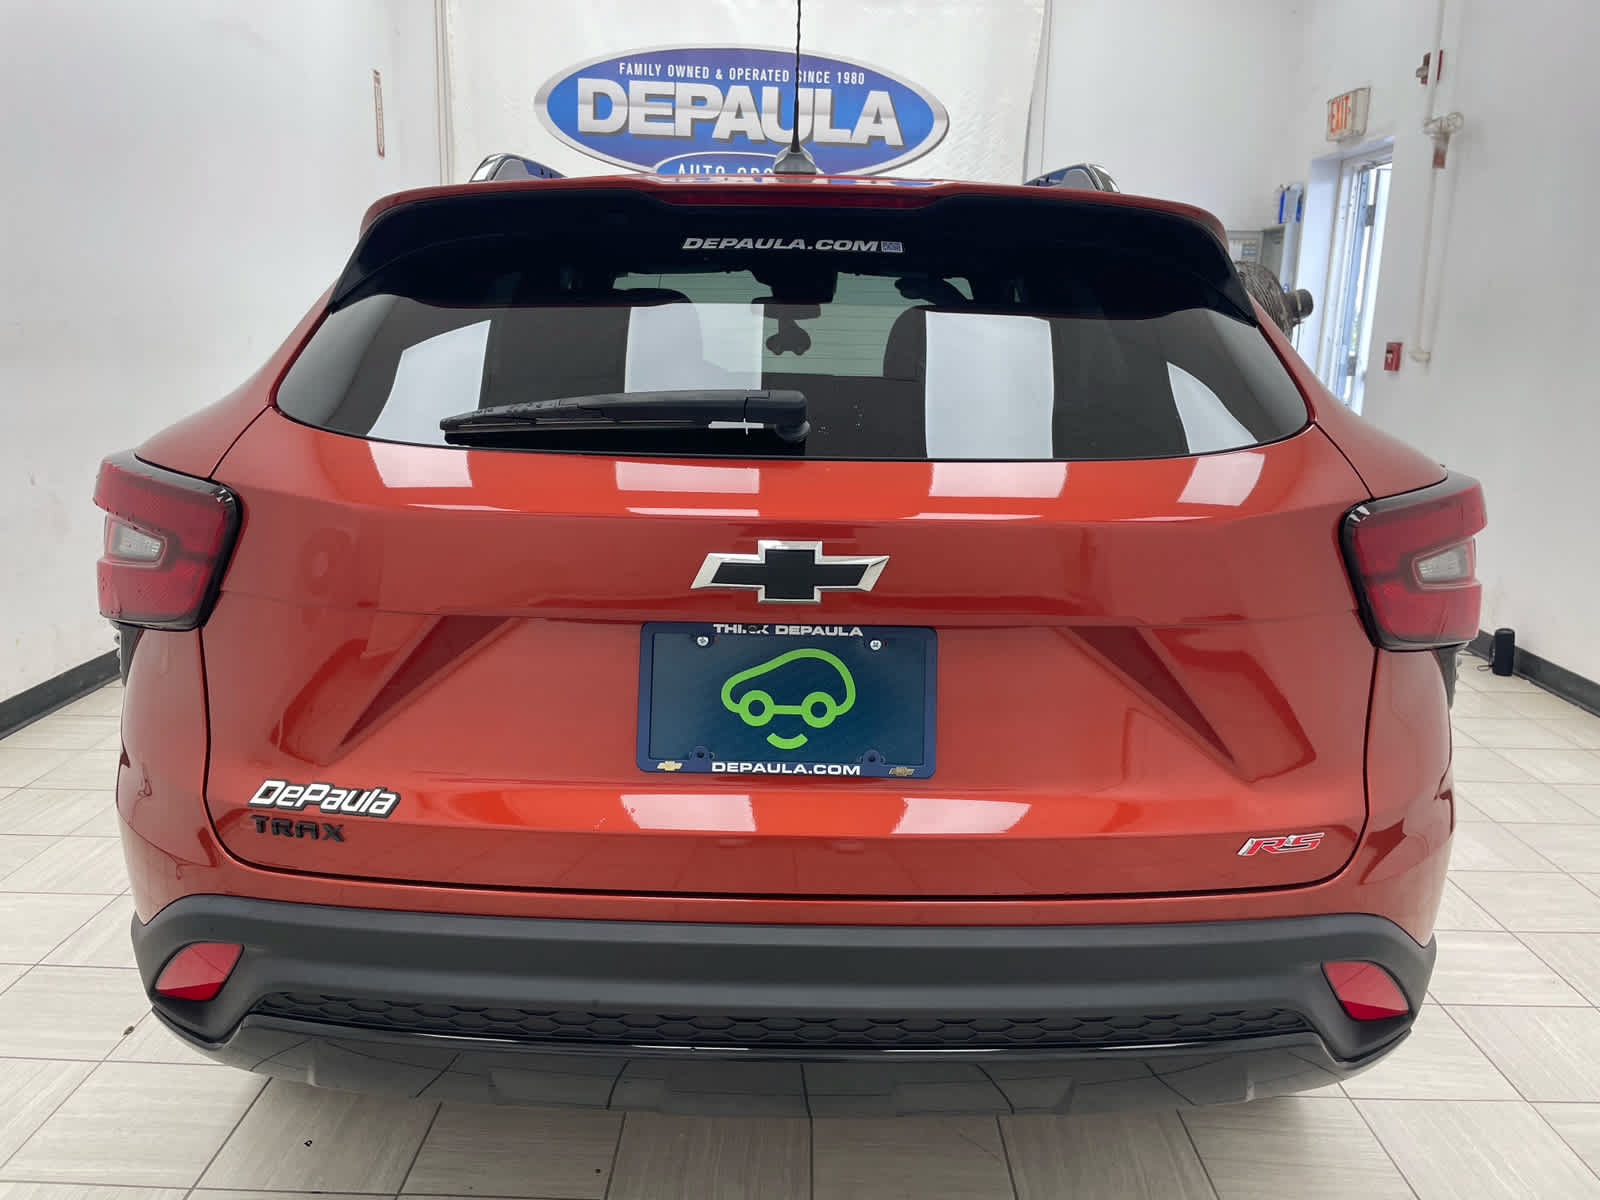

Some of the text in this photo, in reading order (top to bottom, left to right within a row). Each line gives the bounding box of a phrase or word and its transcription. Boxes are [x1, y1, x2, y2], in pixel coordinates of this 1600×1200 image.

[619, 62, 866, 85] FAMILY OWNED & OPERATED SINCE 1980
[577, 78, 905, 148] DEPAULA
[1330, 96, 1350, 134] EXIT
[682, 237, 879, 252] DEPAULA.COM
[775, 624, 864, 637] DEPAULA
[711, 762, 861, 776] DEPAULA.COM
[248, 779, 400, 818] DePaula
[250, 815, 345, 842] TRAX
[1237, 832, 1325, 856] RS
